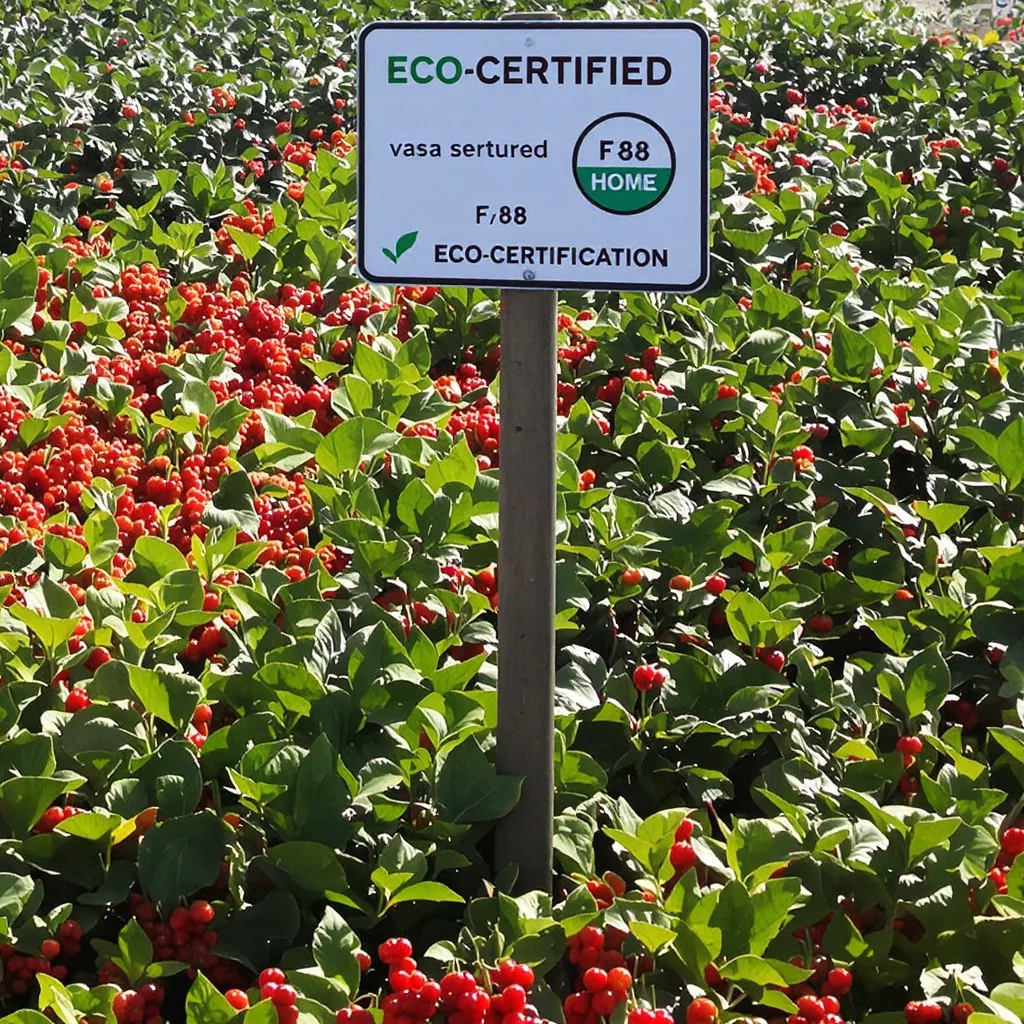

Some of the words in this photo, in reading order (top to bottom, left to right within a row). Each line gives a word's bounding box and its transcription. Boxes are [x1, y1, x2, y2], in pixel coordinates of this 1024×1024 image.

[387, 55, 672, 86] ECO-CERTIFIED
[389, 142, 442, 158] vasa
[450, 139, 548, 159] sertured
[591, 173, 658, 192] HOME
[434, 244, 669, 268] ECO-CERTIFICATION
